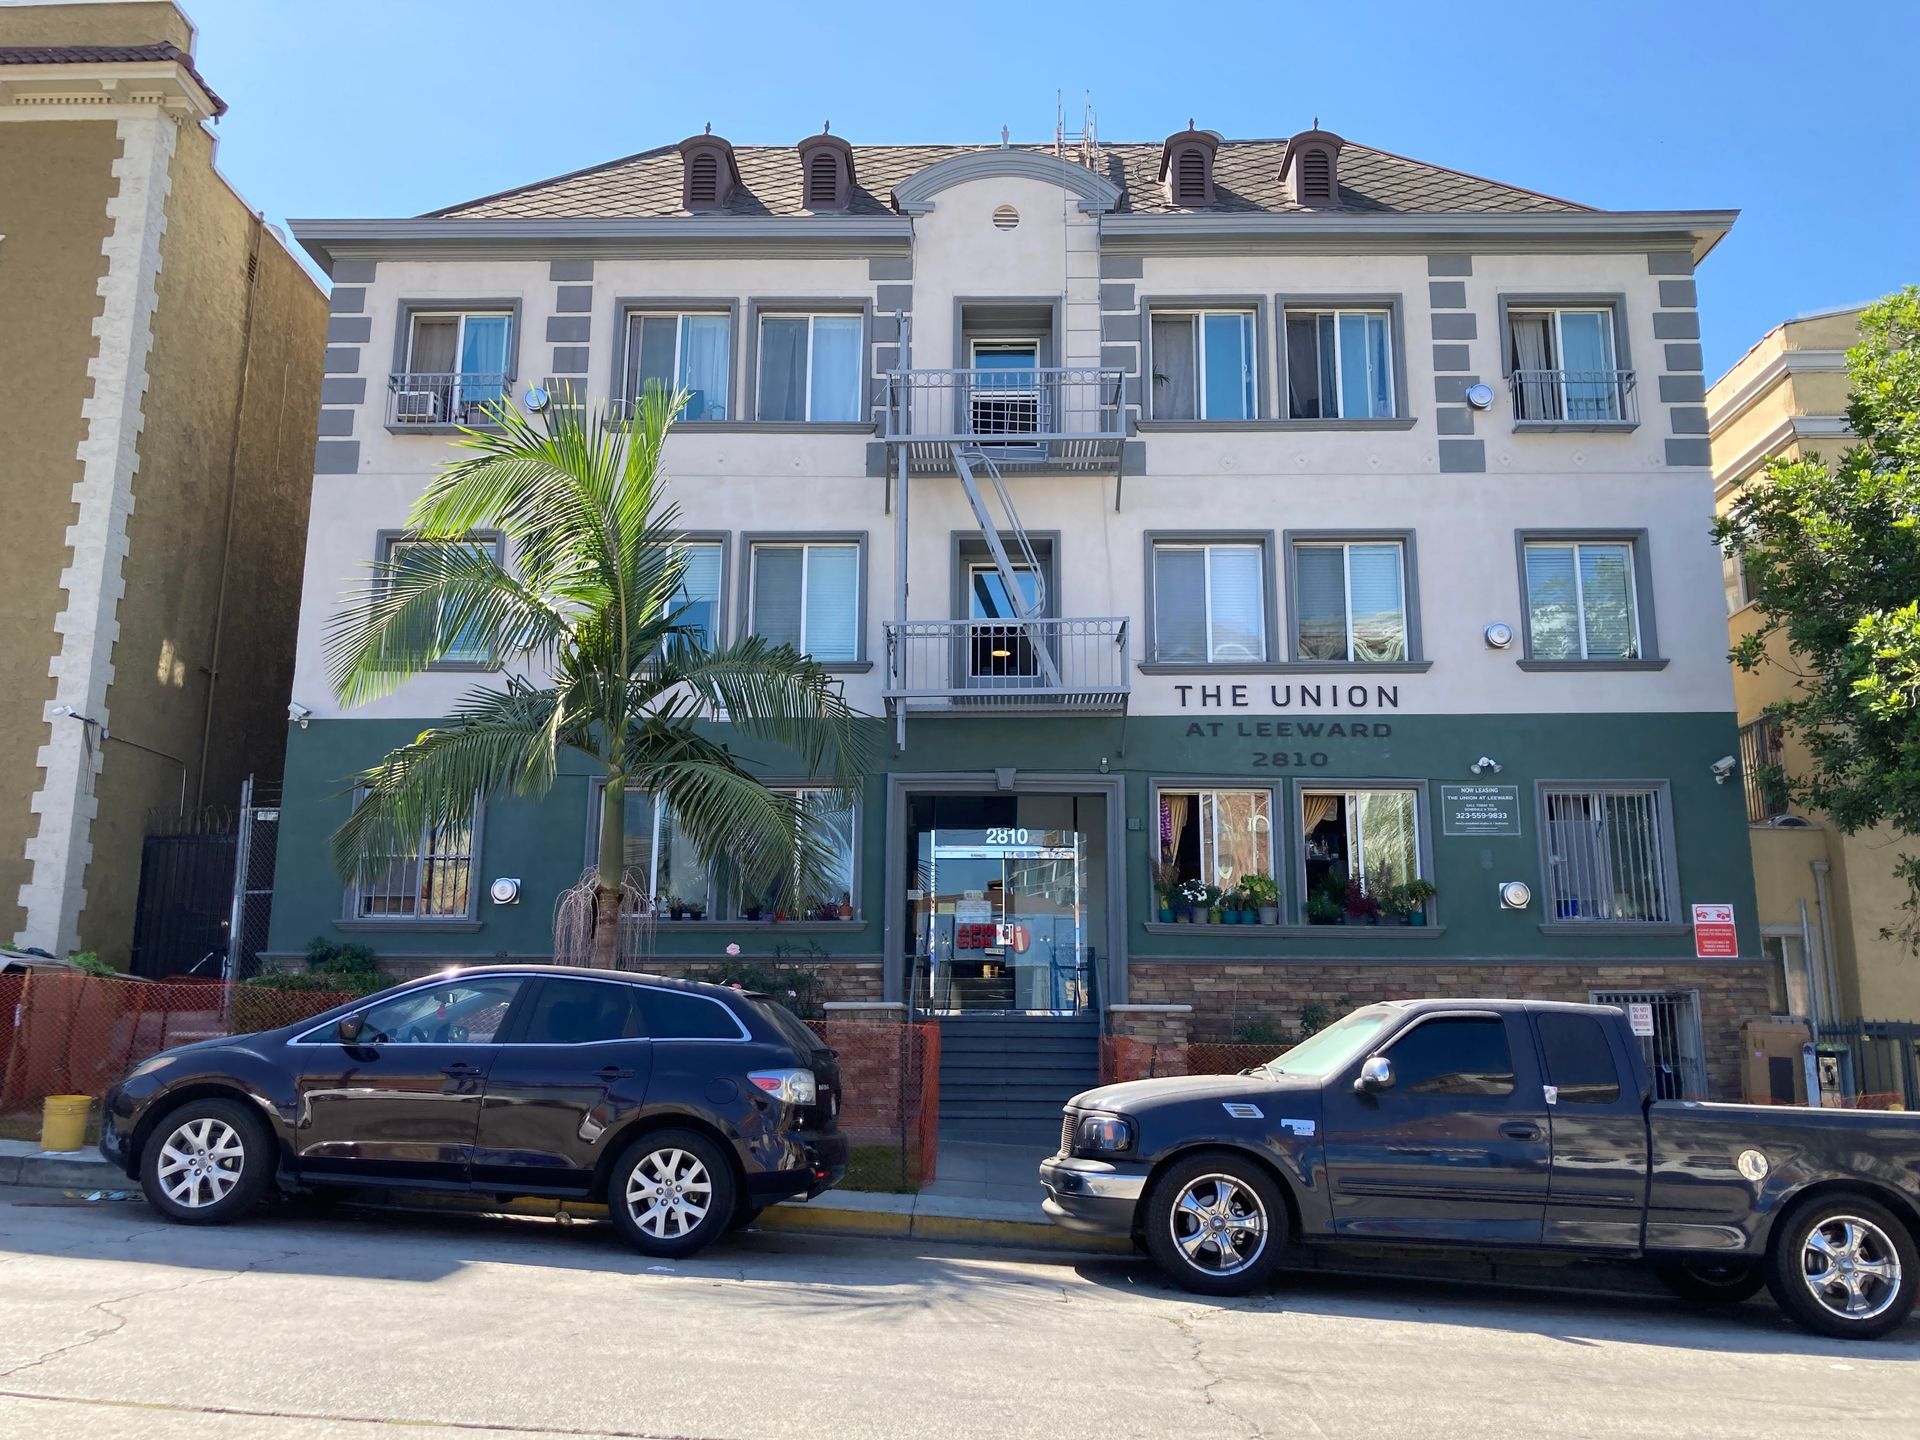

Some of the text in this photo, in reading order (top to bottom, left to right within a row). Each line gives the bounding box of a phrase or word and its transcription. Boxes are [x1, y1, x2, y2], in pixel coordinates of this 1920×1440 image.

[1174, 685, 1399, 708] THE UNION
[1186, 722, 1392, 738] AT LEEWARD
[1252, 752, 1329, 767] 2810
[985, 828, 1029, 845] 2810
